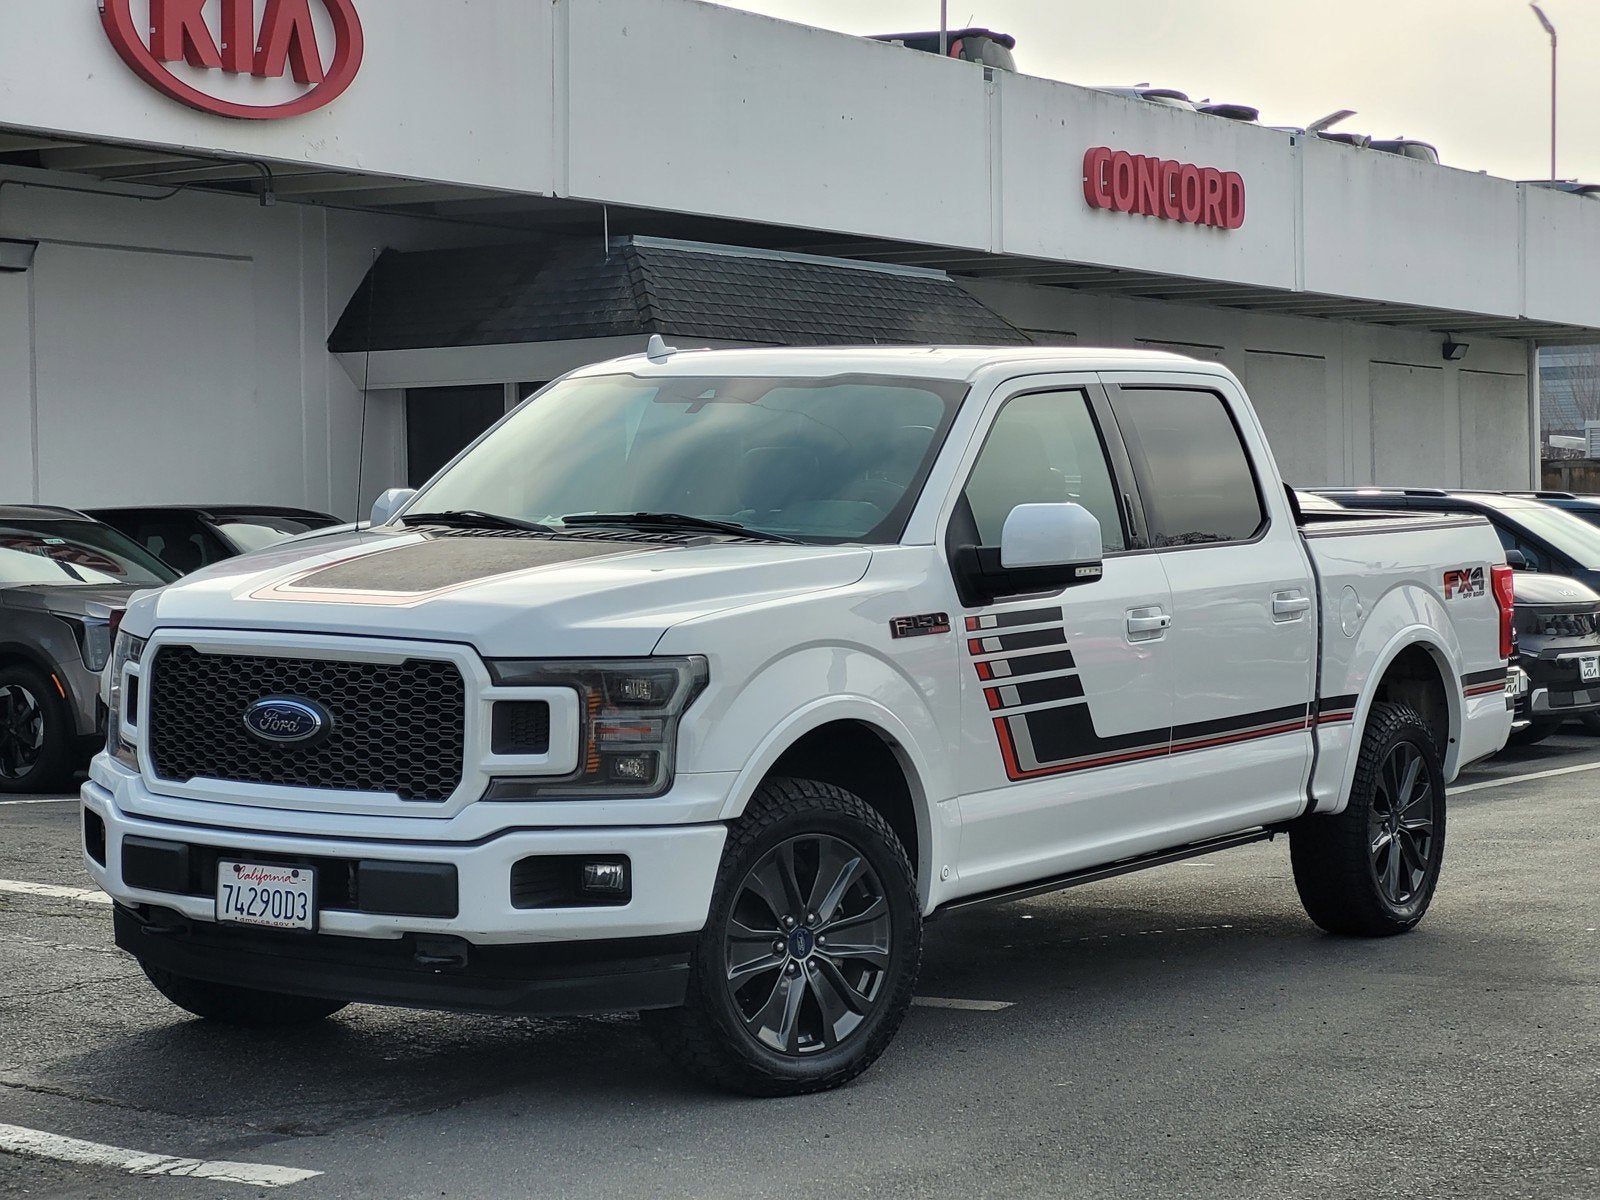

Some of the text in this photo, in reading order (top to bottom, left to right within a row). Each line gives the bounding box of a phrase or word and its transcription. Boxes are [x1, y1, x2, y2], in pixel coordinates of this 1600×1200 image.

[150, 0, 325, 83] KIA
[1083, 147, 1246, 230] CONCORD
[1444, 566, 1485, 600] FX4
[260, 708, 302, 732] Ford
[237, 865, 296, 886] California
[222, 884, 308, 921] 74290D3
